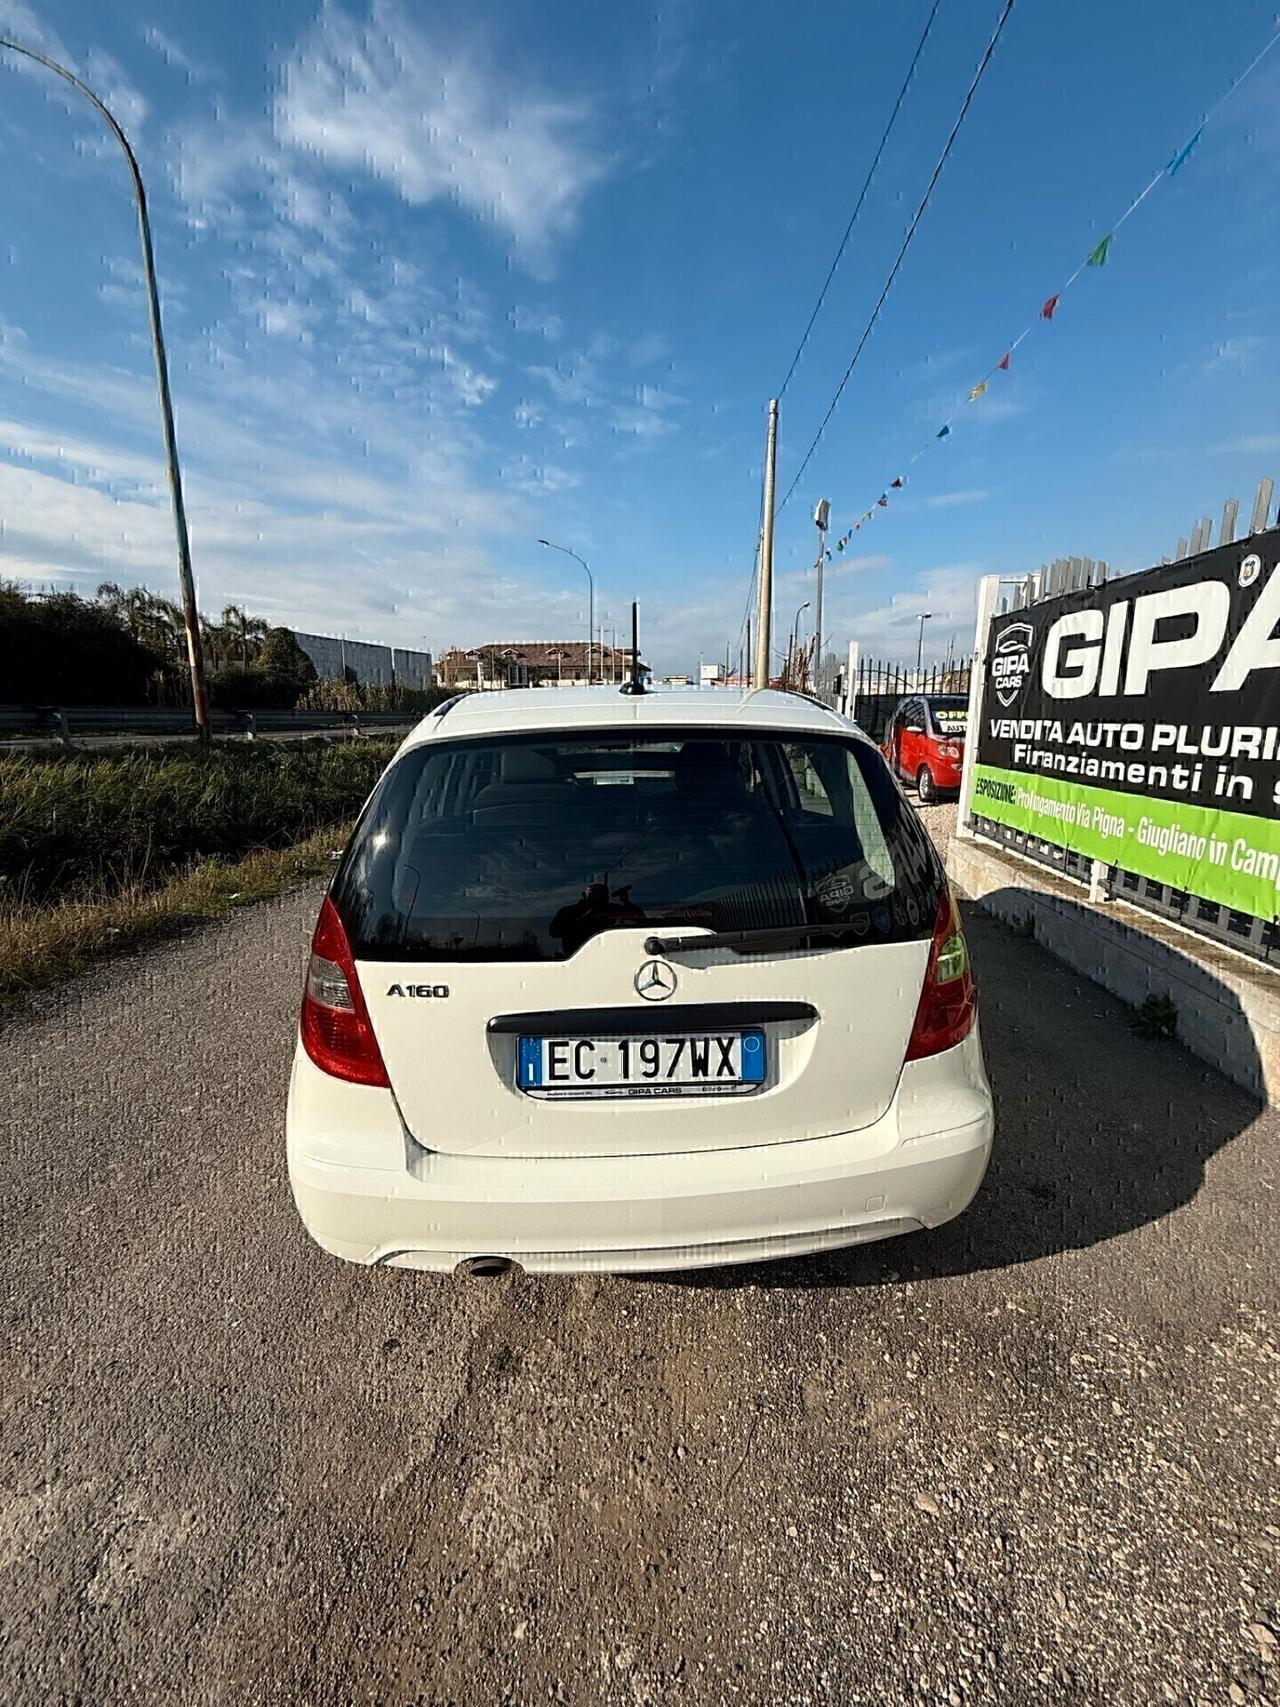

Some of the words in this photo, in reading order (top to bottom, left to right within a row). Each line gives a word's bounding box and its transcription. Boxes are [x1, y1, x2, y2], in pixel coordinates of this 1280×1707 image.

[1042, 560, 1280, 699] GIPA
[992, 653, 1029, 677] GIPA
[995, 675, 1022, 689] CARS
[935, 711, 968, 719] OFF
[990, 718, 1063, 743] VENDITA
[1066, 722, 1145, 751] AUTO
[1151, 723, 1280, 761] PLURI
[1214, 765, 1254, 800] in
[1076, 802, 1091, 828] Via
[1092, 806, 1124, 839] Pigna
[1137, 816, 1206, 862] Giugliano
[1209, 832, 1227, 866] in
[1231, 837, 1280, 891] Cam
[386, 984, 450, 998] A160
[548, 1040, 595, 1081] EC
[618, 1036, 736, 1080] 197WX
[628, 1087, 651, 1095] GIPA
[653, 1086, 682, 1094] CARS
